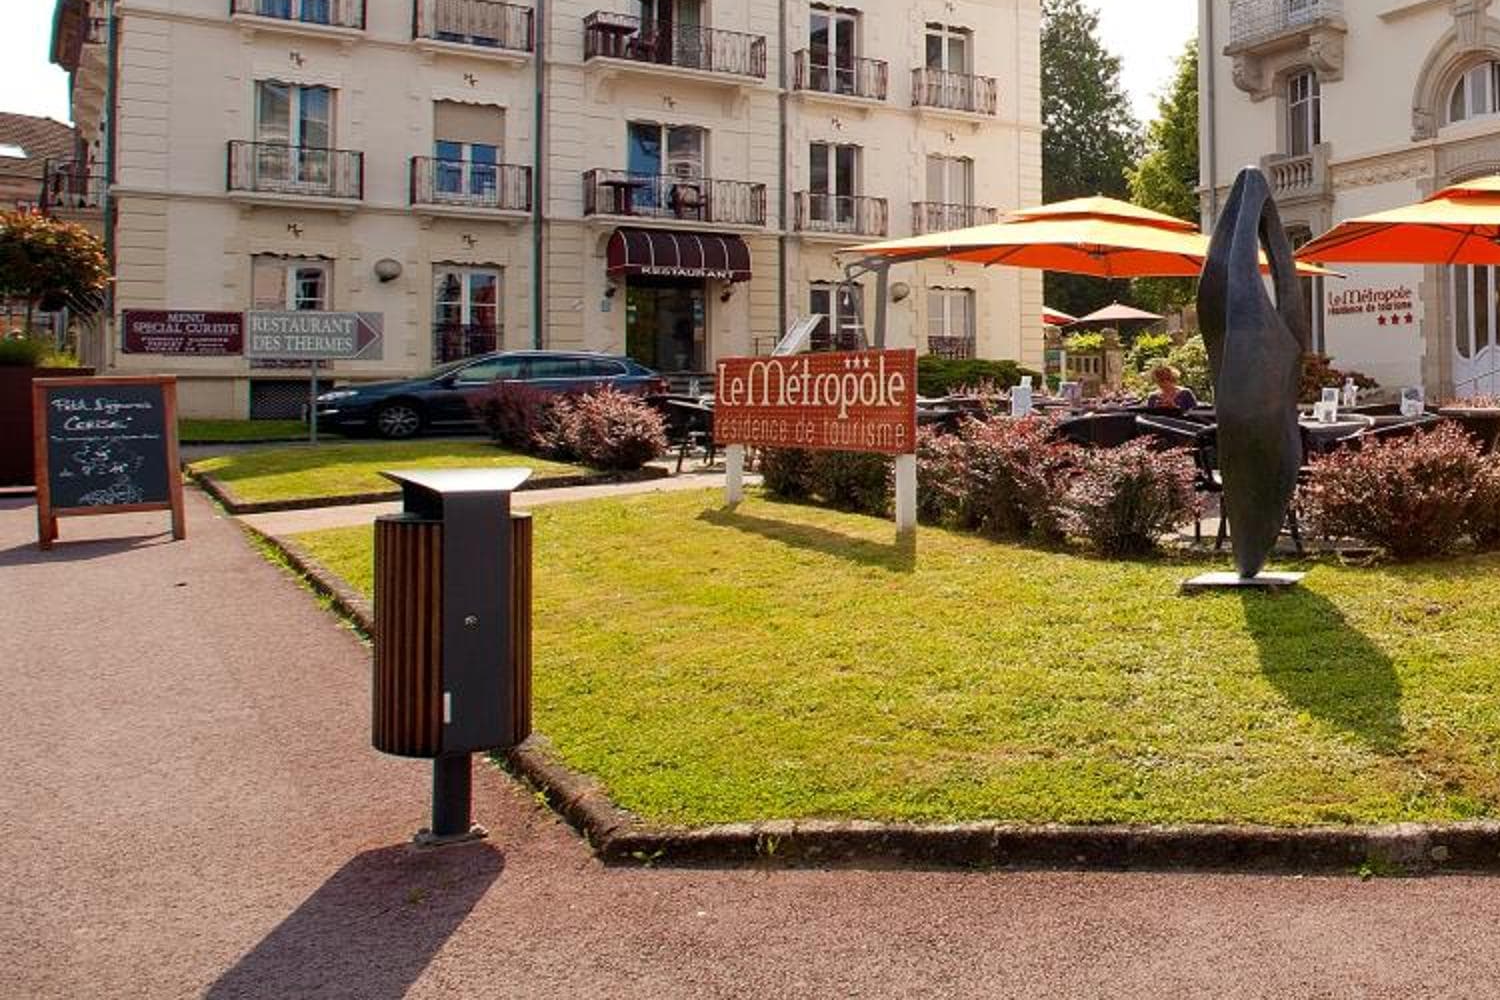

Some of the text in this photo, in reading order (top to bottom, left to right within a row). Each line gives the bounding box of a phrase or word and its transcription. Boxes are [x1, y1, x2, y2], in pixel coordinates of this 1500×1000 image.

[641, 265, 735, 279] RESTAURANT
[167, 313, 205, 323] MENU
[252, 317, 352, 334] RESTAURANT
[253, 335, 352, 351] DES THERMES
[719, 355, 906, 419] Le Métropole
[796, 416, 815, 443] de
[823, 412, 906, 447] tourisme
